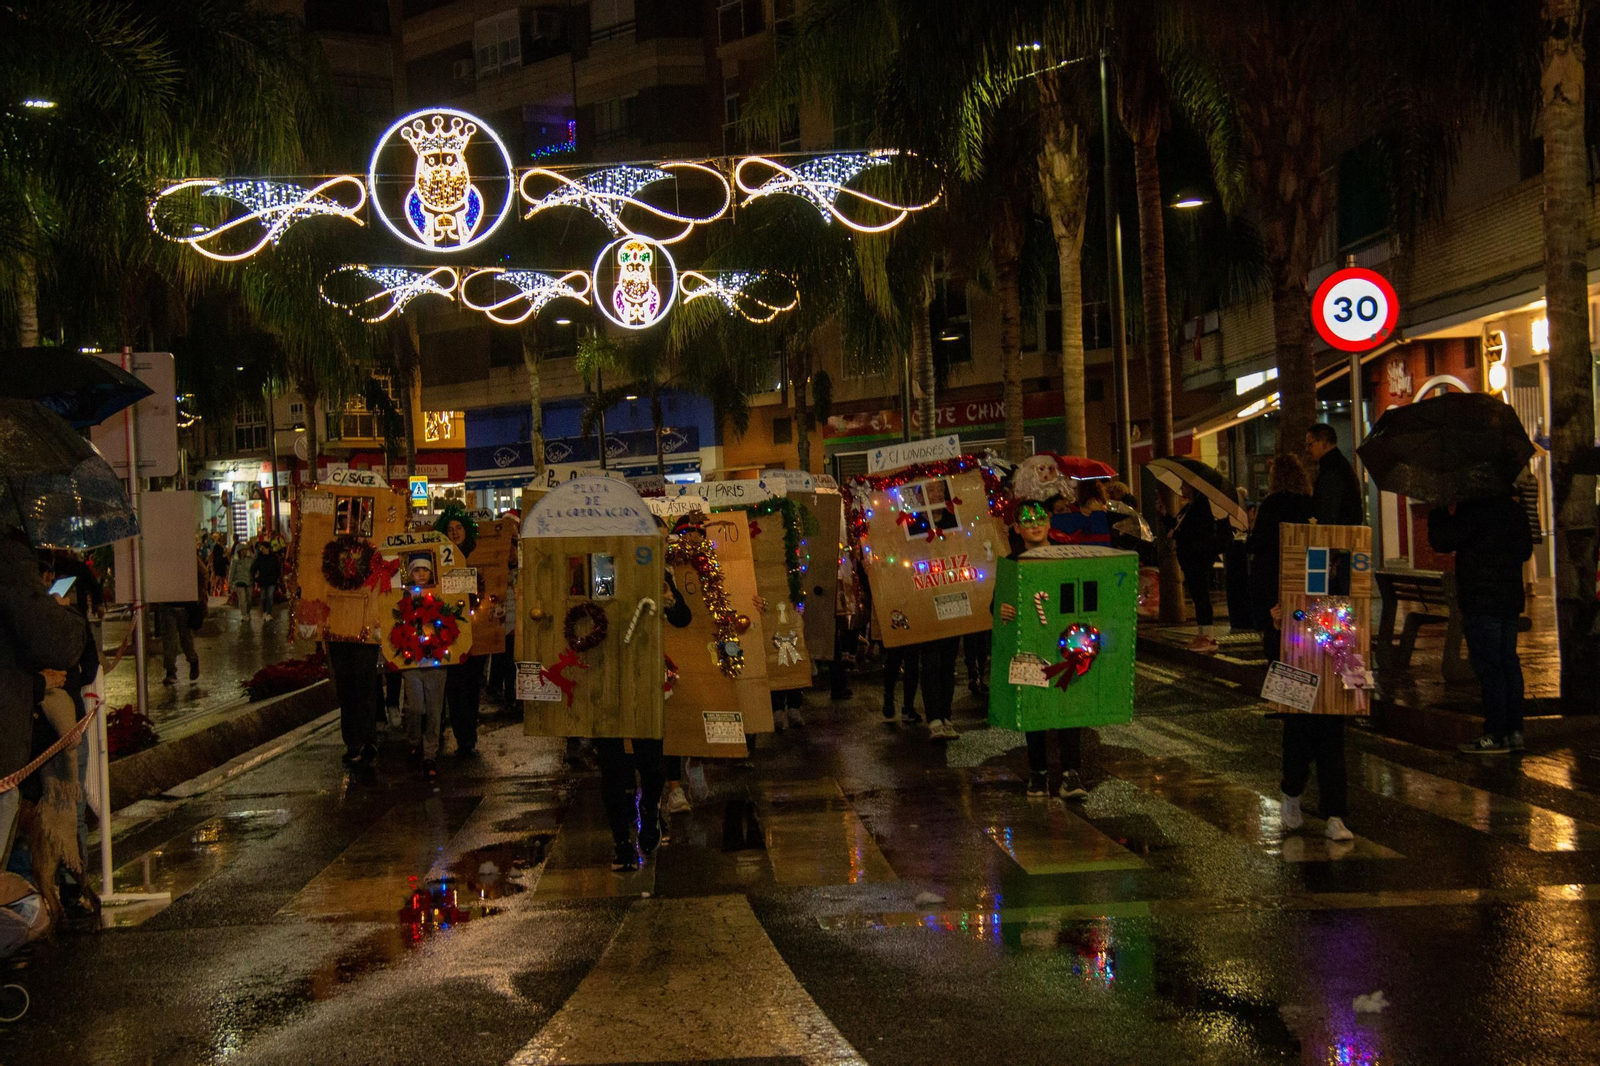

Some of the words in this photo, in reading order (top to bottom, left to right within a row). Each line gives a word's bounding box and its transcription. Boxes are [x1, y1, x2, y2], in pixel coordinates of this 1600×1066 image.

[1333, 295, 1378, 323] 30
[966, 401, 1006, 421] CHIN
[902, 444, 944, 461] LONDRES
[715, 483, 745, 498] PARIS
[585, 496, 601, 506] DE
[717, 519, 739, 544] 10
[442, 547, 453, 563] 2
[635, 546, 653, 566] 9
[912, 553, 971, 575] FELIZ
[1352, 553, 1370, 571] 8
[684, 571, 697, 595] 6
[912, 566, 978, 590] NAVIDAD
[1113, 571, 1128, 588] 7
